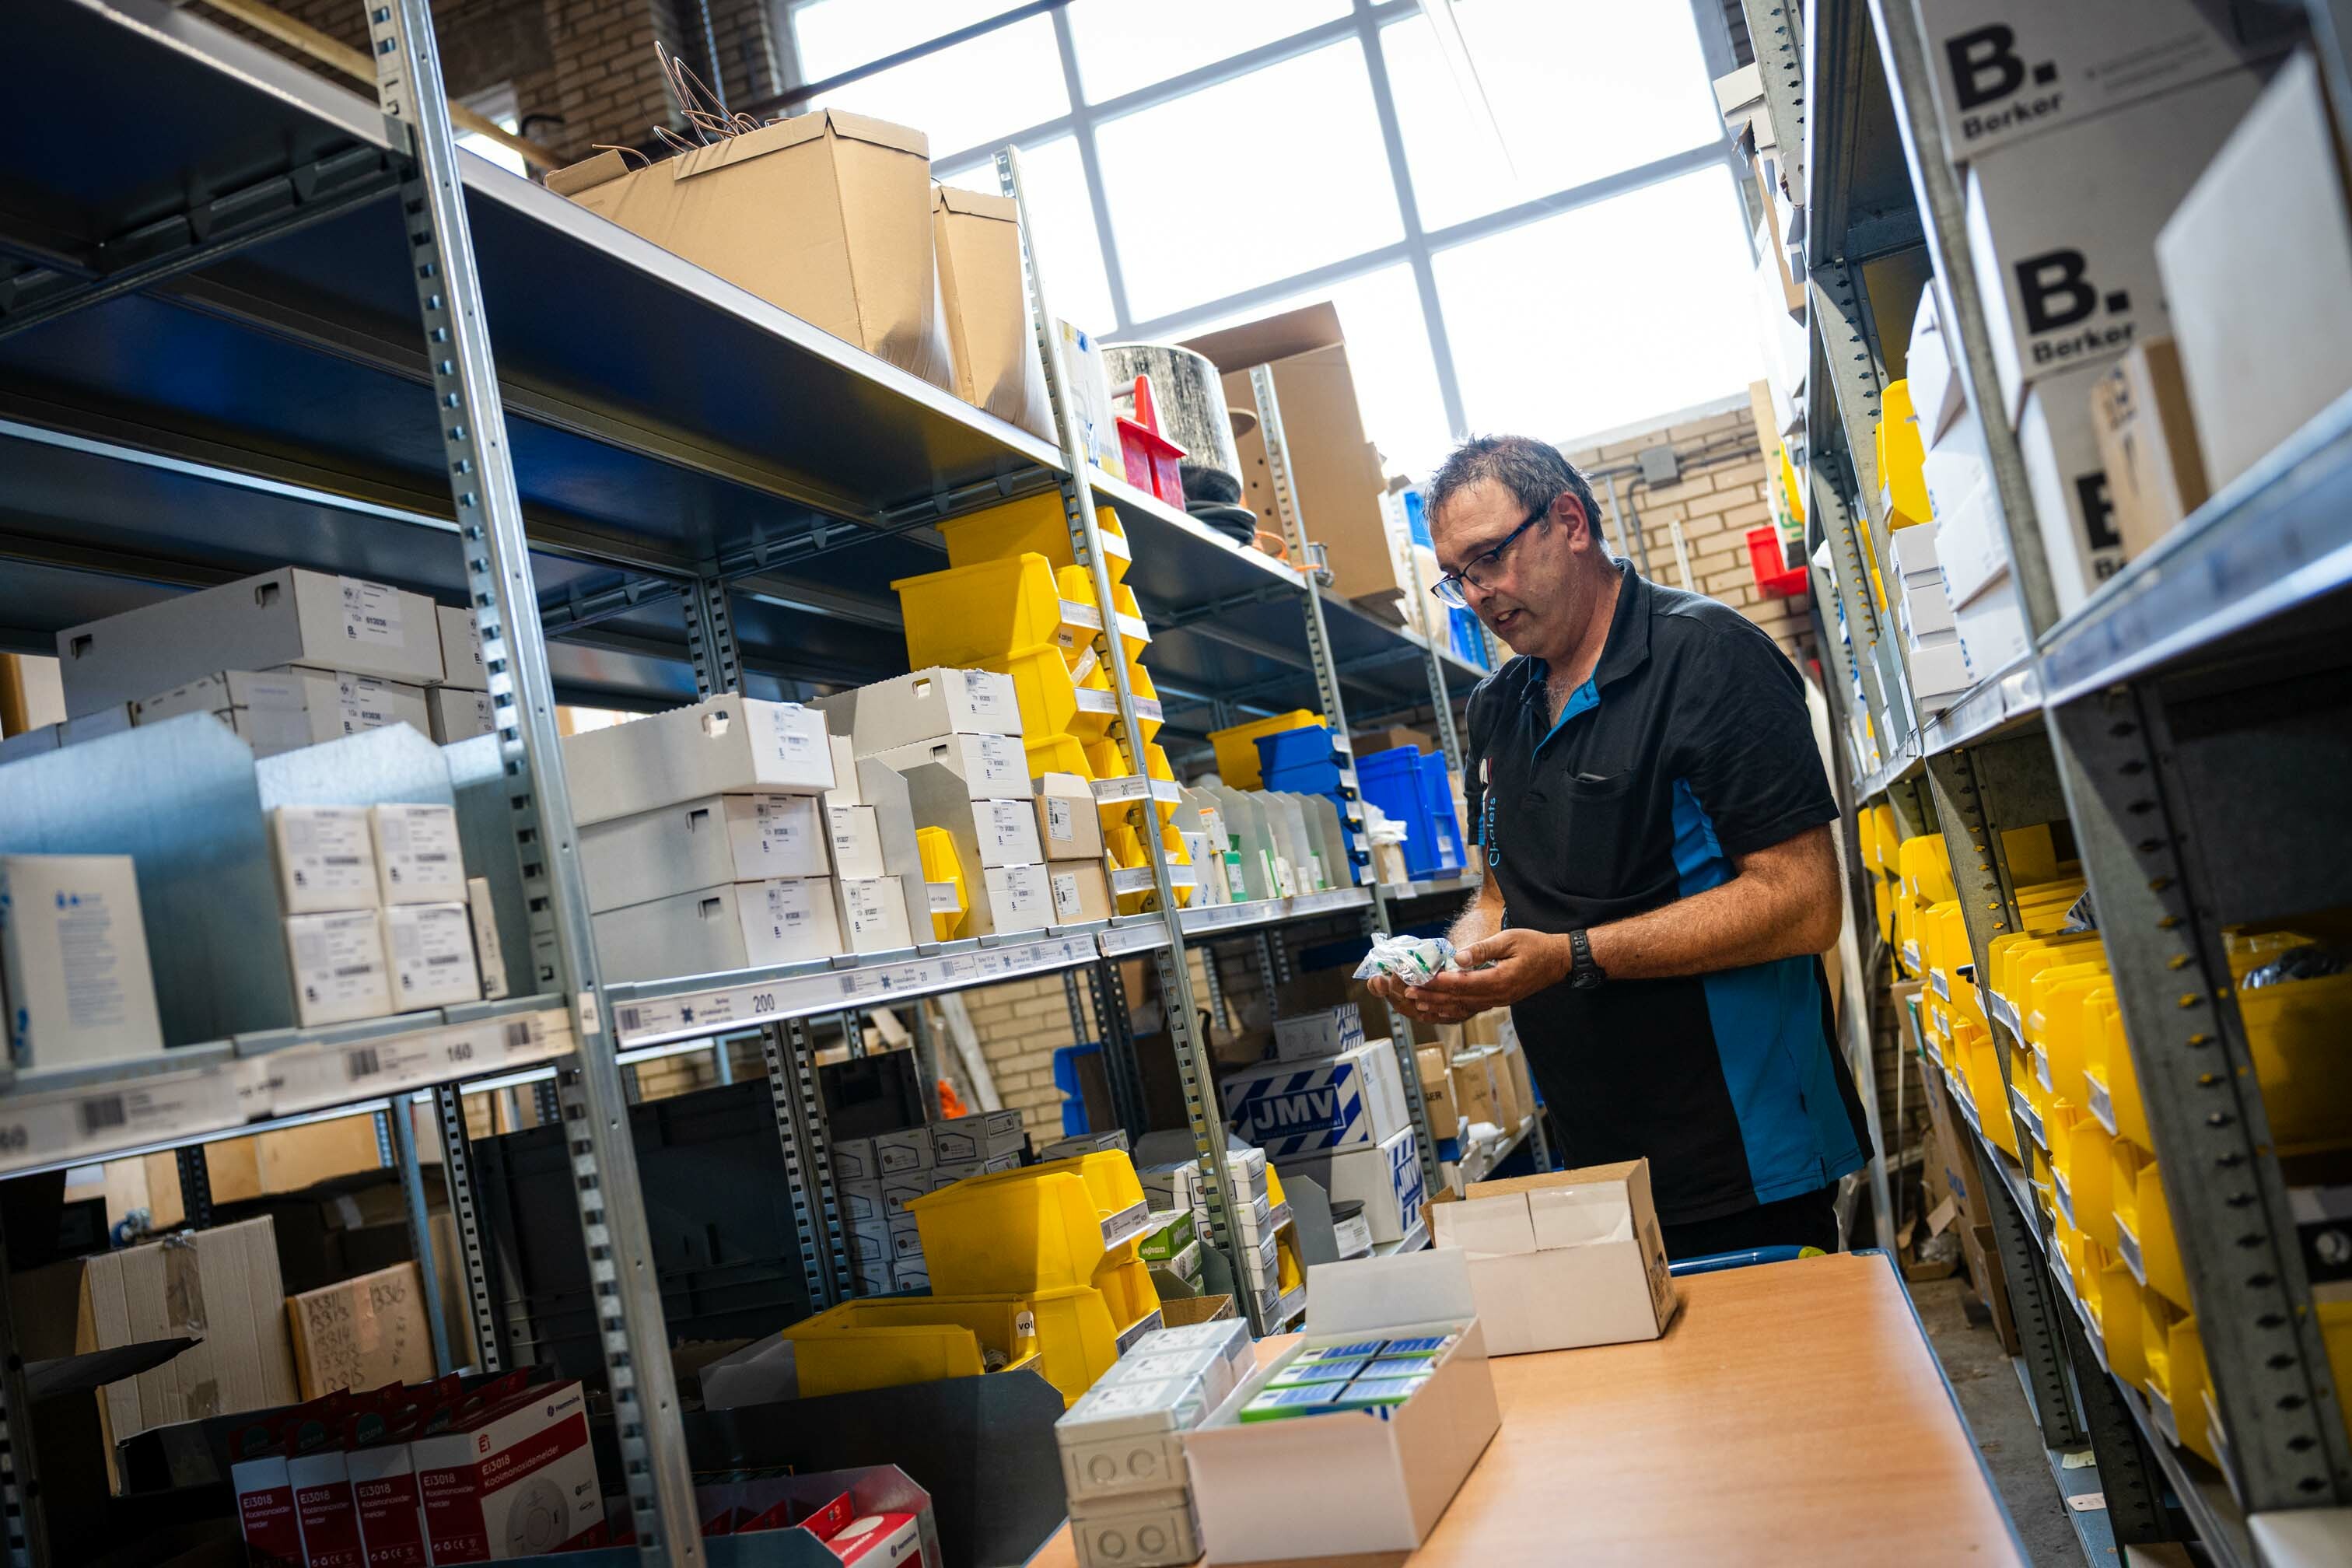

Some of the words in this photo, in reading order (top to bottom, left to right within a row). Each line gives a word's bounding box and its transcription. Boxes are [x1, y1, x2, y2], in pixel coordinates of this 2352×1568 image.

[1945, 22, 2056, 112] B.
[1962, 92, 2063, 140] Berker
[2014, 247, 2131, 335] B.
[2032, 321, 2134, 364] Berker
[1486, 796, 1500, 867] Chalets
[752, 992, 775, 1013] 200
[1342, 1013, 1362, 1034] JMV
[1255, 1090, 1334, 1129] JMV
[1398, 1167, 1422, 1201] JMV
[1142, 1245, 1166, 1255] WAGO
[1018, 1320, 1033, 1330] vol
[481, 1454, 511, 1475] Ei3018
[484, 1444, 559, 1489] Koolmonoxidemelder
[359, 1482, 392, 1498] Ei3018
[423, 1473, 456, 1487] Ei3018
[243, 1494, 273, 1509] Ei3018
[299, 1489, 331, 1505] Ei3018
[428, 1500, 450, 1509] melder
[247, 1520, 268, 1530] melder
[304, 1517, 326, 1526] melder
[363, 1510, 387, 1520] melder
